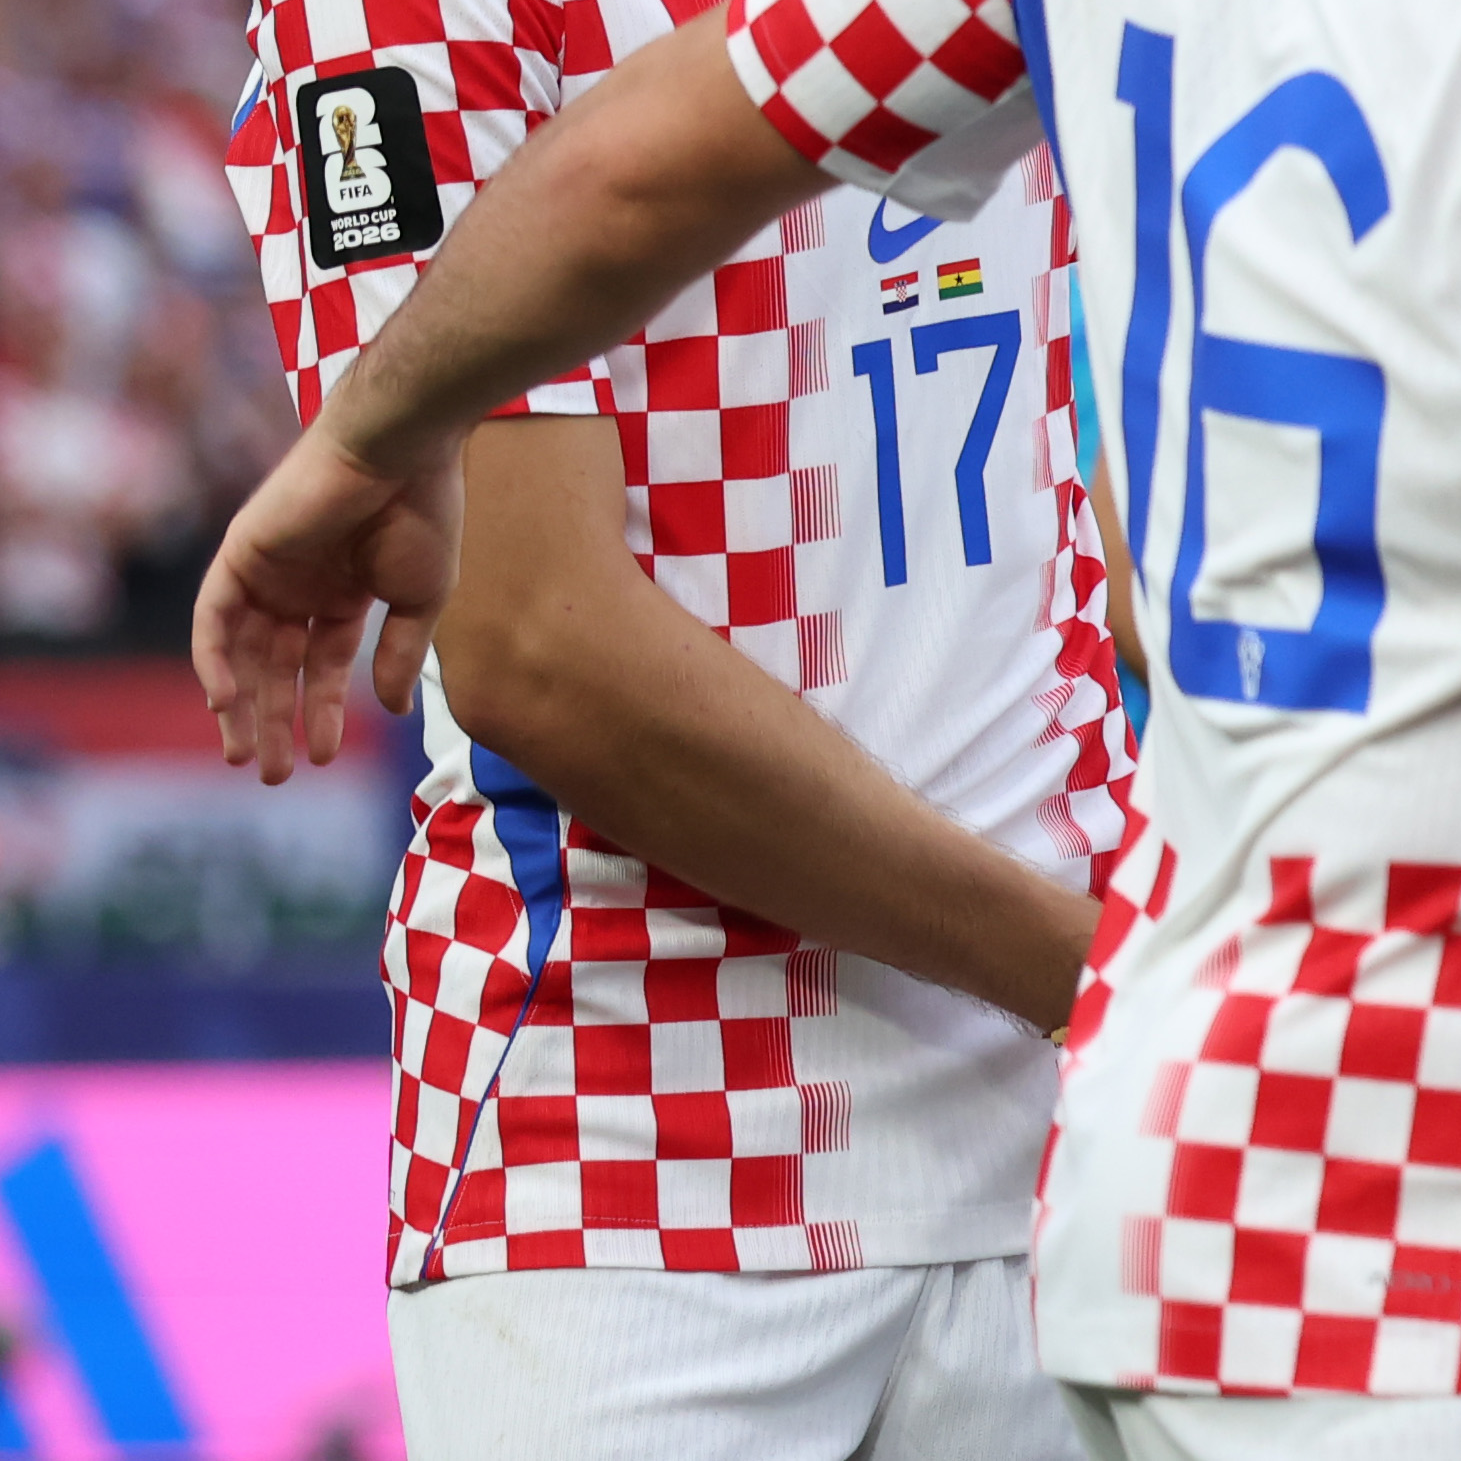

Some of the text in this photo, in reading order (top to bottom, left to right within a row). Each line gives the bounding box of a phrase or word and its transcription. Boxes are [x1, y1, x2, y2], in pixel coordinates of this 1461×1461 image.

[340, 184, 373, 201] FIFA
[330, 208, 397, 232] WORLD CUP
[332, 222, 401, 252] 2026
[1115, 18, 1391, 717] 16
[851, 309, 1022, 588] 17
